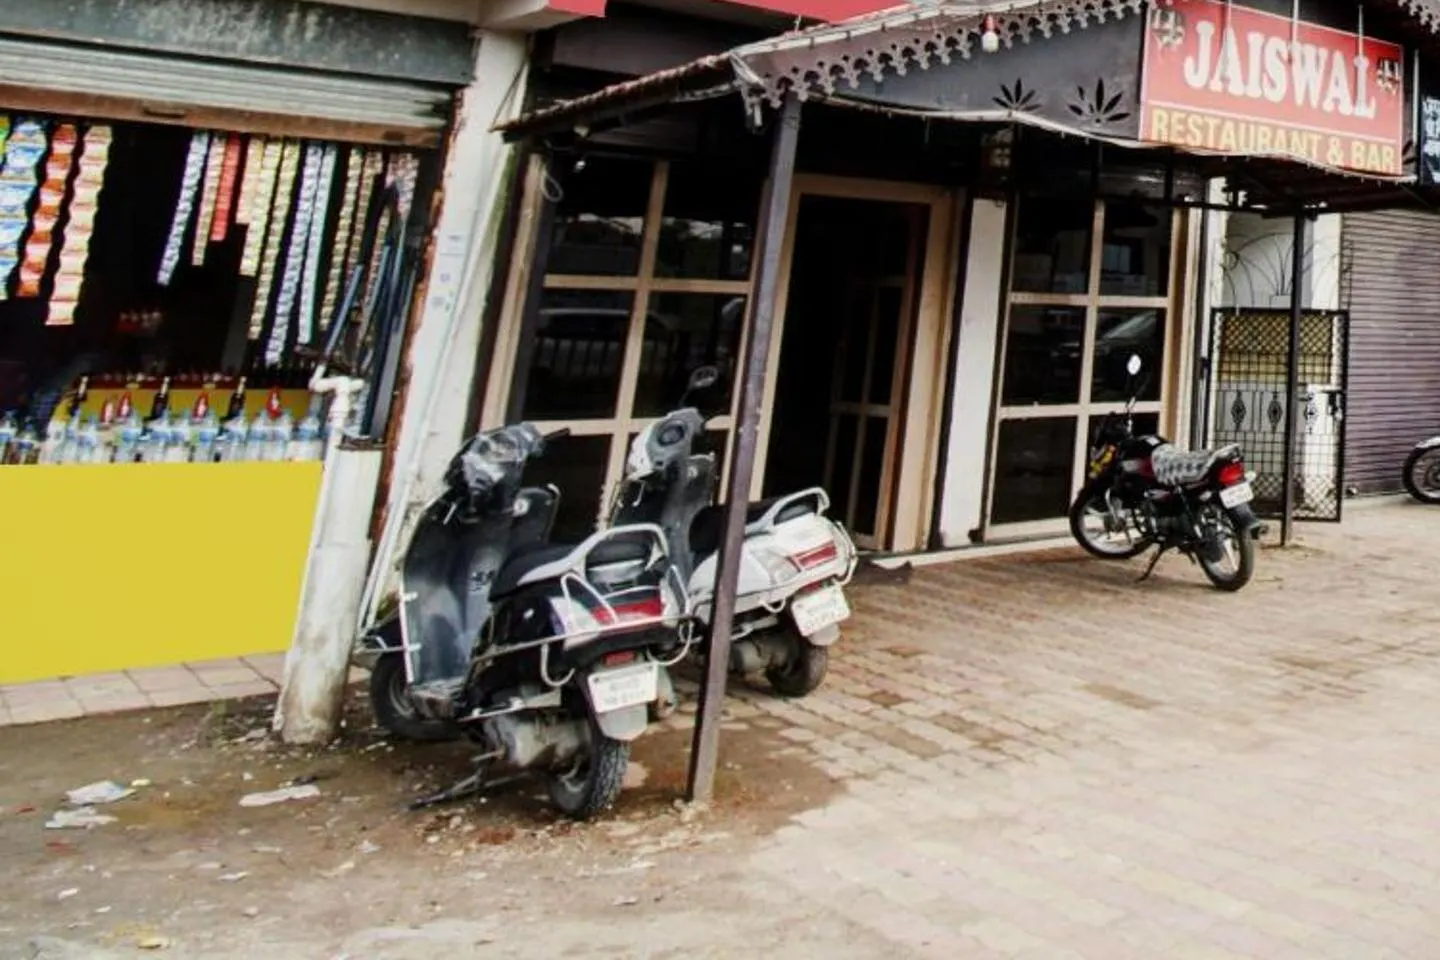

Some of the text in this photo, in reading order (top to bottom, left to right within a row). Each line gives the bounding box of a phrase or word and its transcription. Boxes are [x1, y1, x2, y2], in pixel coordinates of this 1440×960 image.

[1184, 20, 1376, 120] JAISWAL
[1151, 107, 1395, 173] RESTAURANT & BAR
